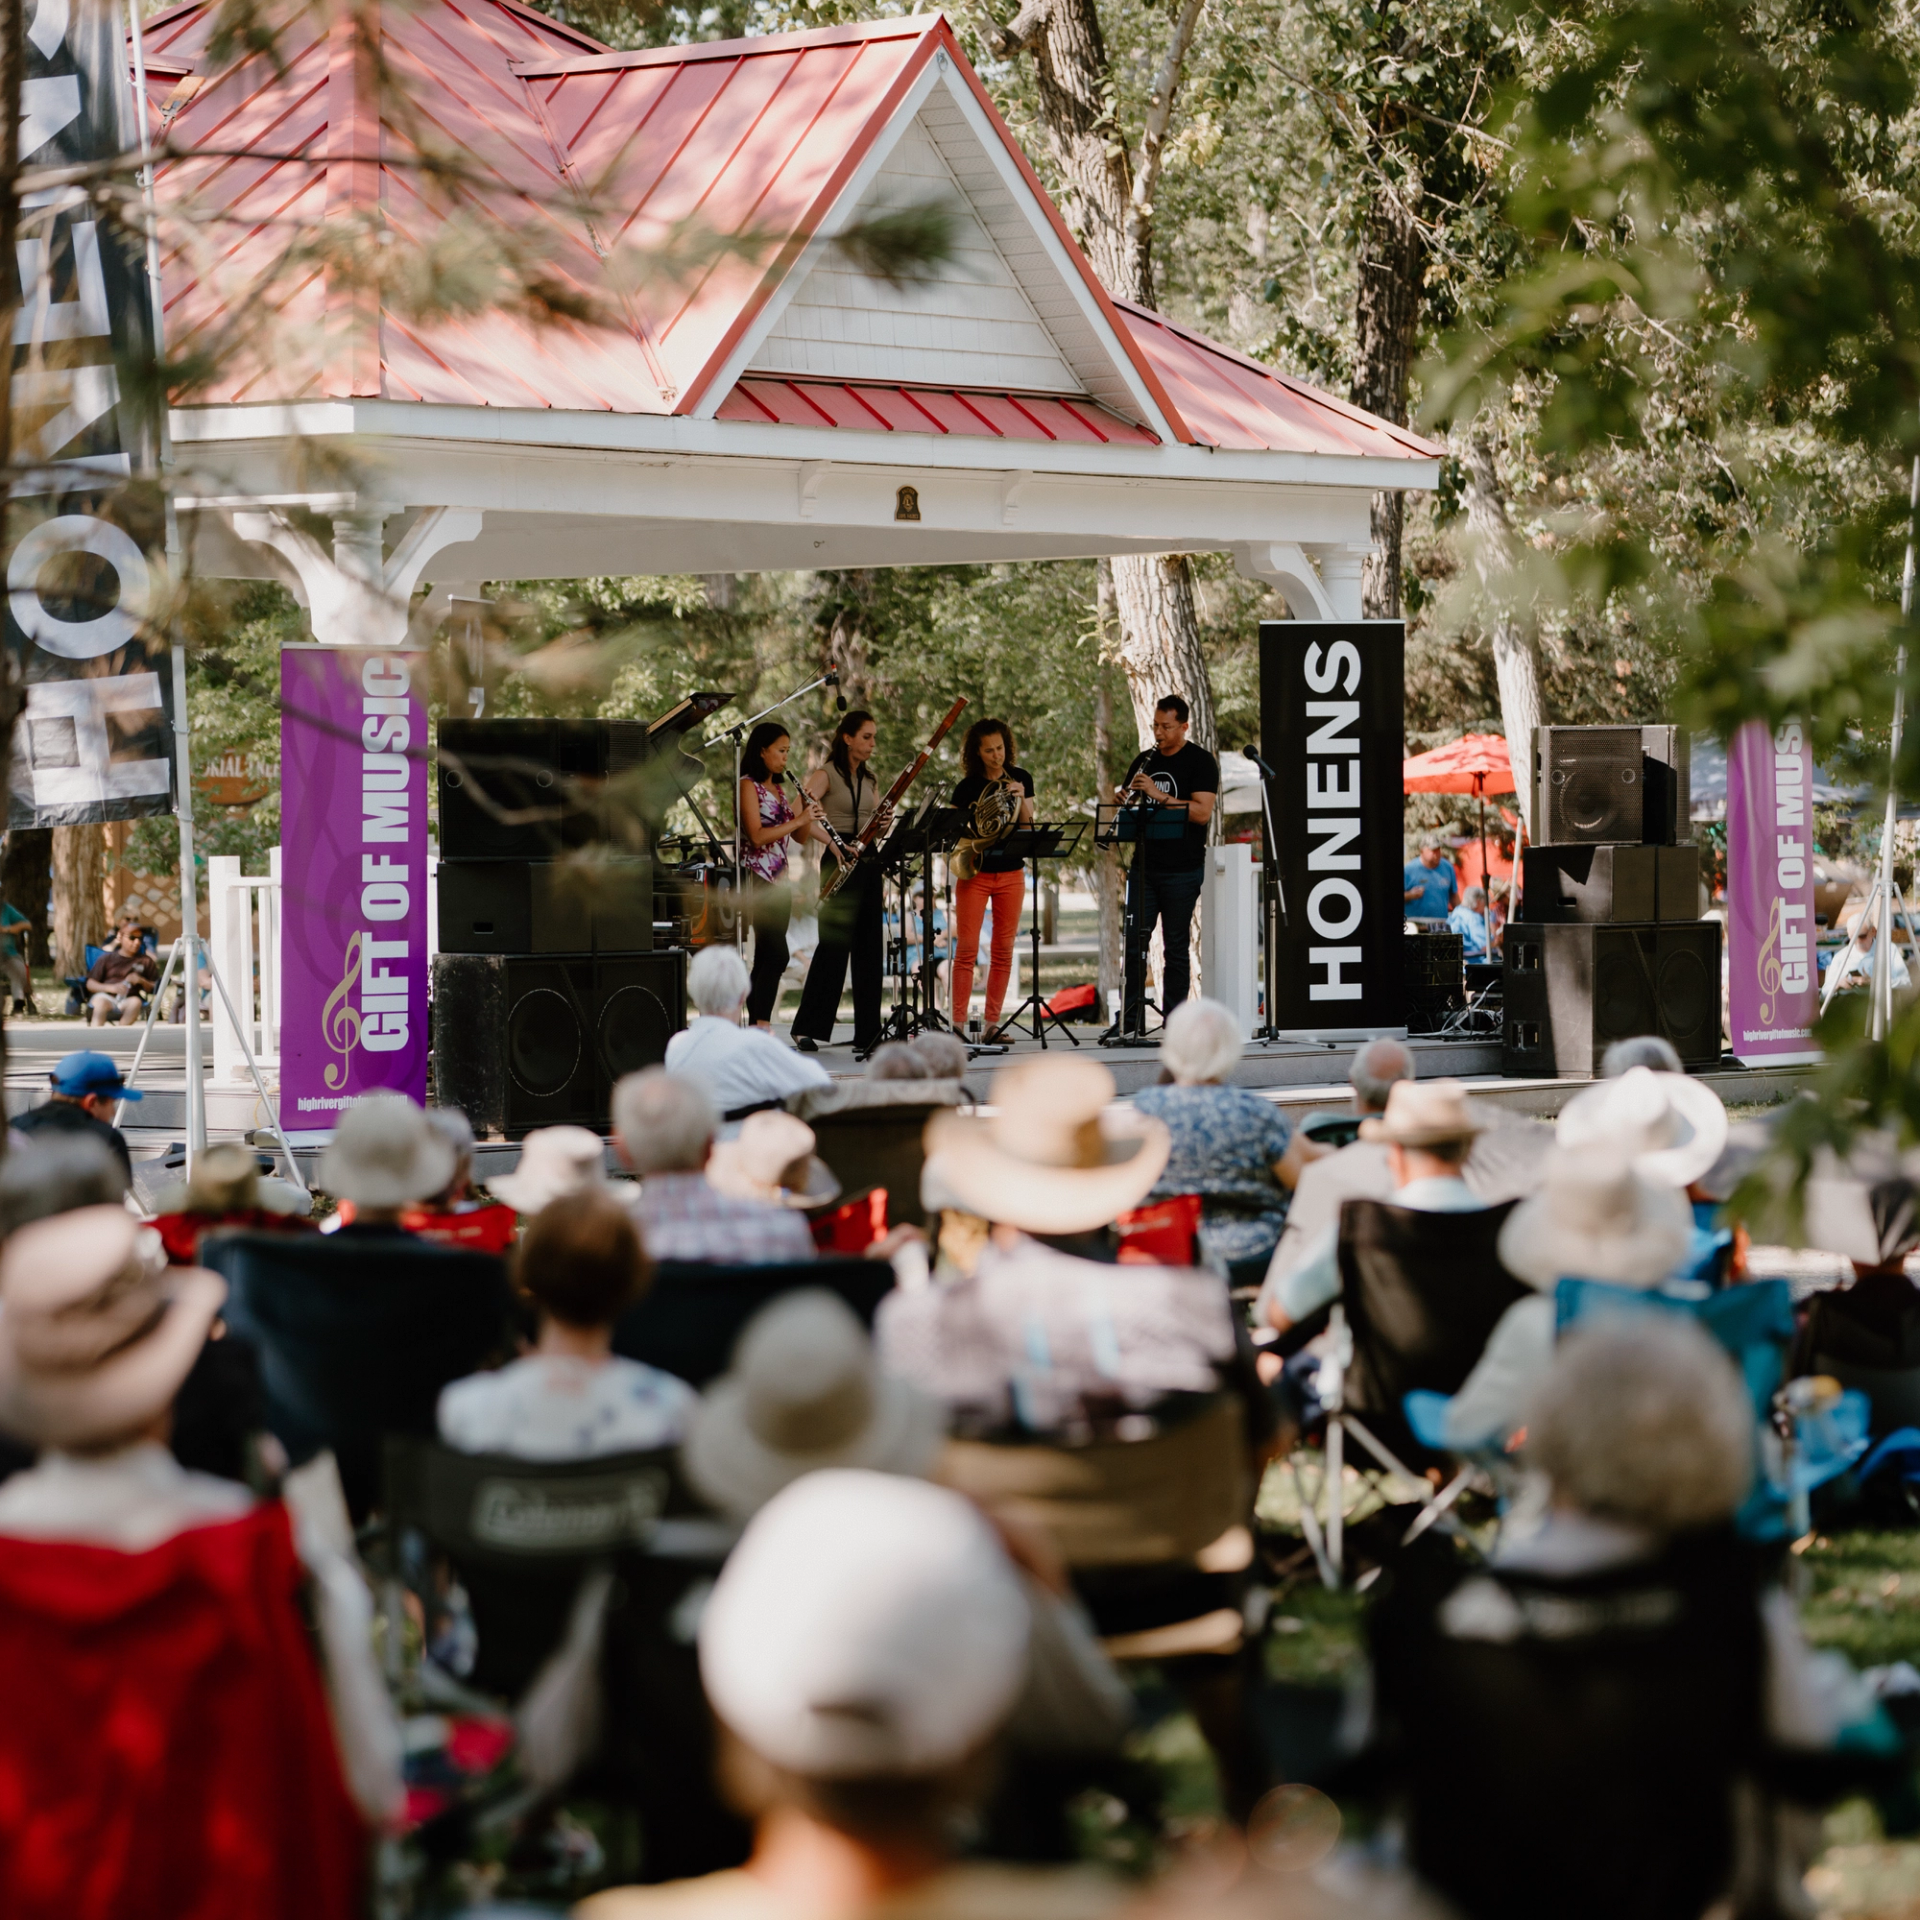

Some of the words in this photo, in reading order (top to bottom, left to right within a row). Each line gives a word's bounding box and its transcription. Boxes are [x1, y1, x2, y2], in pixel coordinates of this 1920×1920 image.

[361, 657, 411, 843] MUSIC
[1774, 711, 1805, 826] MUSI
[1304, 640, 1363, 1001] HONENS
[1776, 834, 1806, 889] OF
[360, 853, 410, 922] OF
[360, 931, 410, 1052] GIFT
[1778, 897, 1810, 995] GIFT
